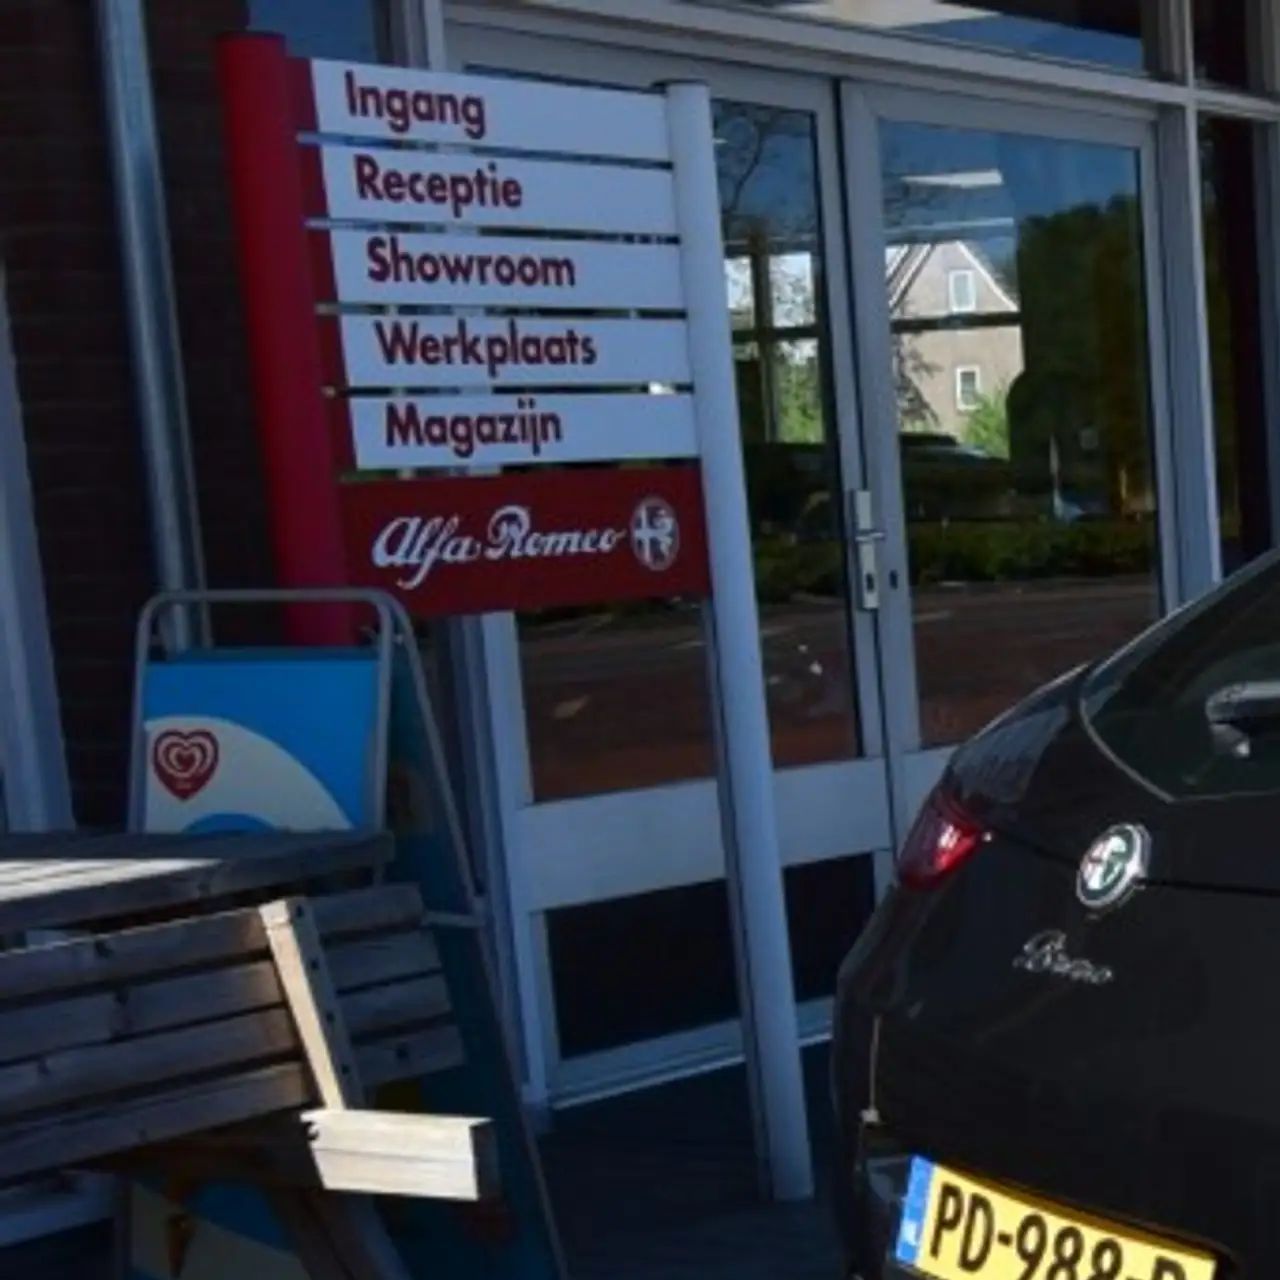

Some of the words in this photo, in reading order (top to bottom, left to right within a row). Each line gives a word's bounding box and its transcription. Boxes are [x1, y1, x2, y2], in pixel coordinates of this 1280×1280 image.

[345, 71, 486, 138] Ingang
[355, 156, 522, 218] Receptie
[367, 237, 576, 288] Showroom
[375, 320, 597, 378] Werkplaats
[386, 399, 563, 455] Magazijn
[372, 515, 480, 590] Alfa
[487, 505, 625, 561] Romeo
